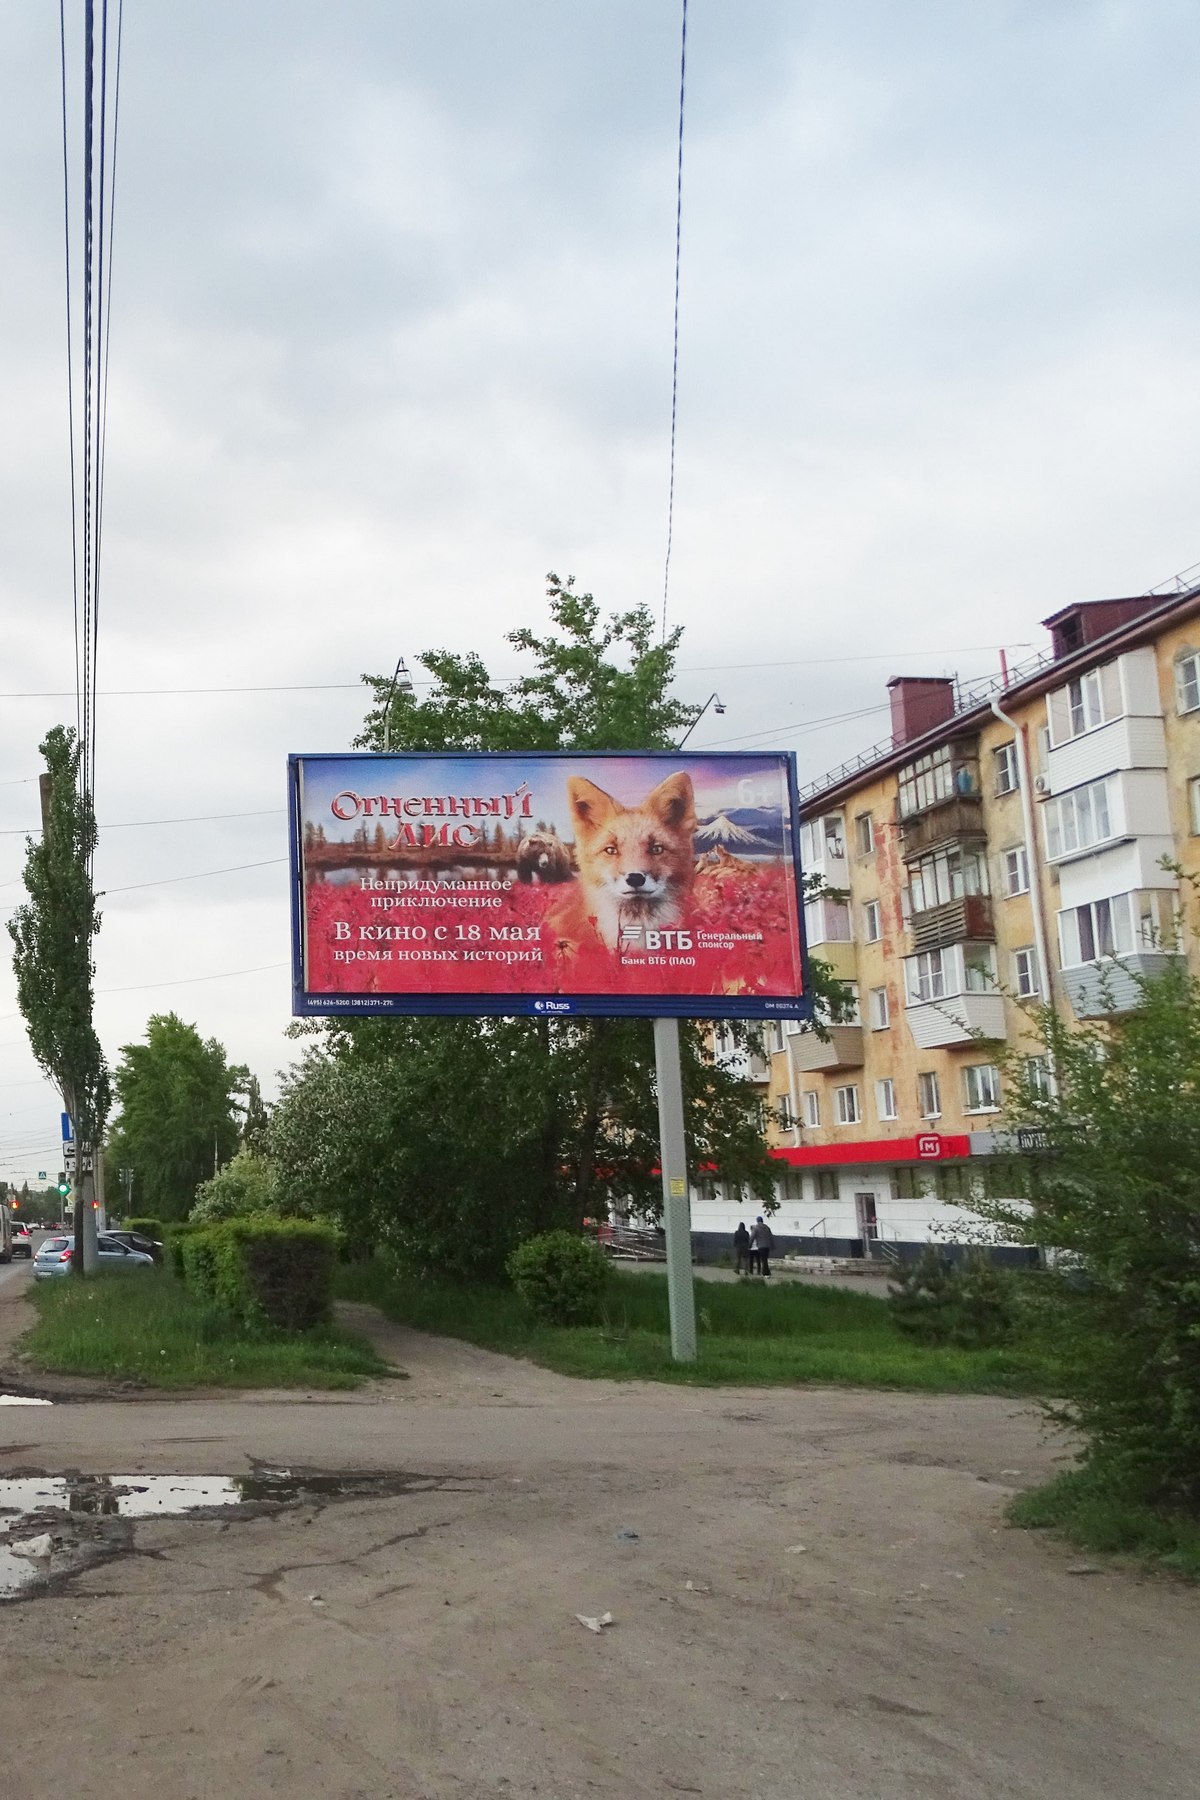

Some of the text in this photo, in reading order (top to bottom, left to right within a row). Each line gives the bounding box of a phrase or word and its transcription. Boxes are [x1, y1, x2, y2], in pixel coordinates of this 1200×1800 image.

[331, 782, 533, 820] Огненный
[360, 877, 512, 893] Непридуманное
[371, 896, 502, 908] приключение
[334, 921, 541, 940] В кино с 18 мая
[697, 930, 763, 940] Генеральный
[645, 930, 693, 950] ВТБ
[698, 942, 734, 950] спонсор
[334, 948, 543, 964] время новых историй
[621, 956, 696, 966] Банк ВТБ (ПАО)
[545, 1001, 570, 1010] Russ
